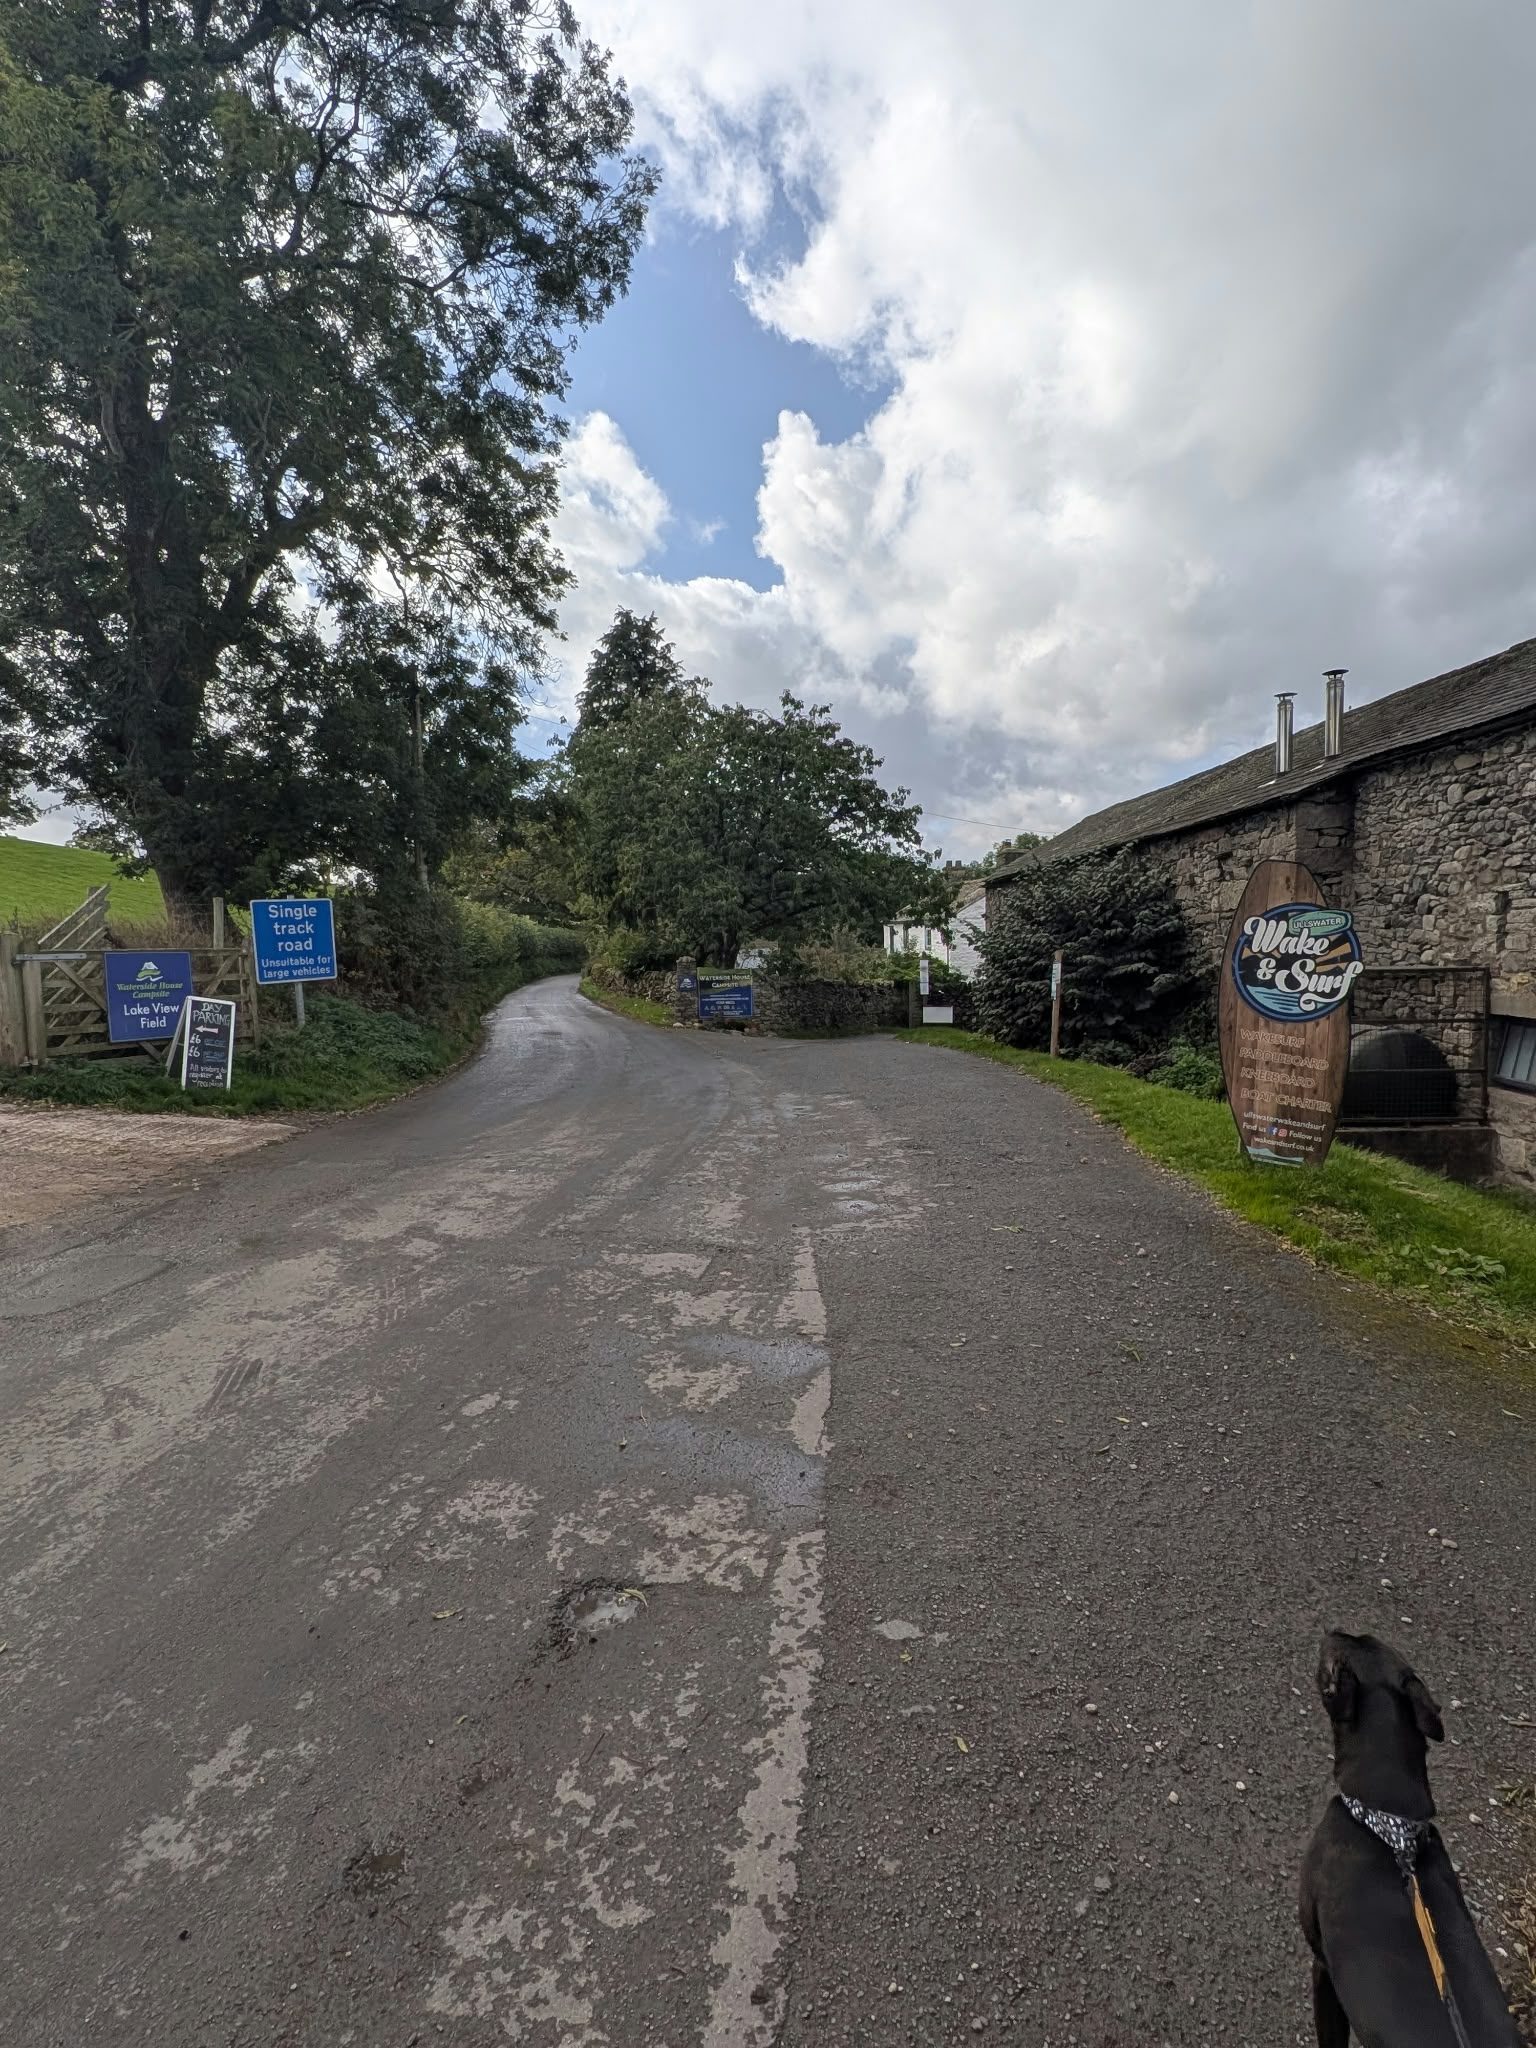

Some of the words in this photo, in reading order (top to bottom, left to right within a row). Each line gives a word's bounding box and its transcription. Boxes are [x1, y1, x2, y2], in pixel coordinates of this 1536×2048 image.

[268, 904, 317, 920] Single
[273, 921, 314, 935] track
[1293, 917, 1342, 929] ULLSWATER
[1243, 917, 1329, 956] Wake
[277, 937, 313, 951] road
[261, 956, 314, 968] Unsuitable
[317, 955, 331, 964] for
[264, 969, 289, 979] large
[292, 966, 330, 976] vehicles
[116, 982, 157, 991] Waterside
[1256, 957, 1276, 980] &
[1275, 958, 1364, 1011] Surf
[132, 990, 170, 999] Campsite
[123, 1003, 150, 1016] Lake
[152, 1002, 180, 1014] View
[201, 1002, 223, 1013] DAY
[140, 1016, 167, 1029] Field
[192, 1010, 231, 1026] PARKING
[189, 1033, 201, 1045] £6
[1240, 1029, 1306, 1048] WAKESURF
[188, 1045, 201, 1057] £6
[1239, 1047, 1329, 1071] PADDLEBOARD
[1240, 1066, 1316, 1088] KNEEBOARD
[1240, 1088, 1275, 1102] BOAT
[1276, 1094, 1332, 1113] CHARTER
[1243, 1111, 1326, 1132] ullswaterwakeandsurf
[1242, 1122, 1257, 1131] Find
[1258, 1125, 1267, 1133] us
[1289, 1130, 1313, 1140] Follow
[1253, 1136, 1314, 1152] wakeandsurf.co.uk
